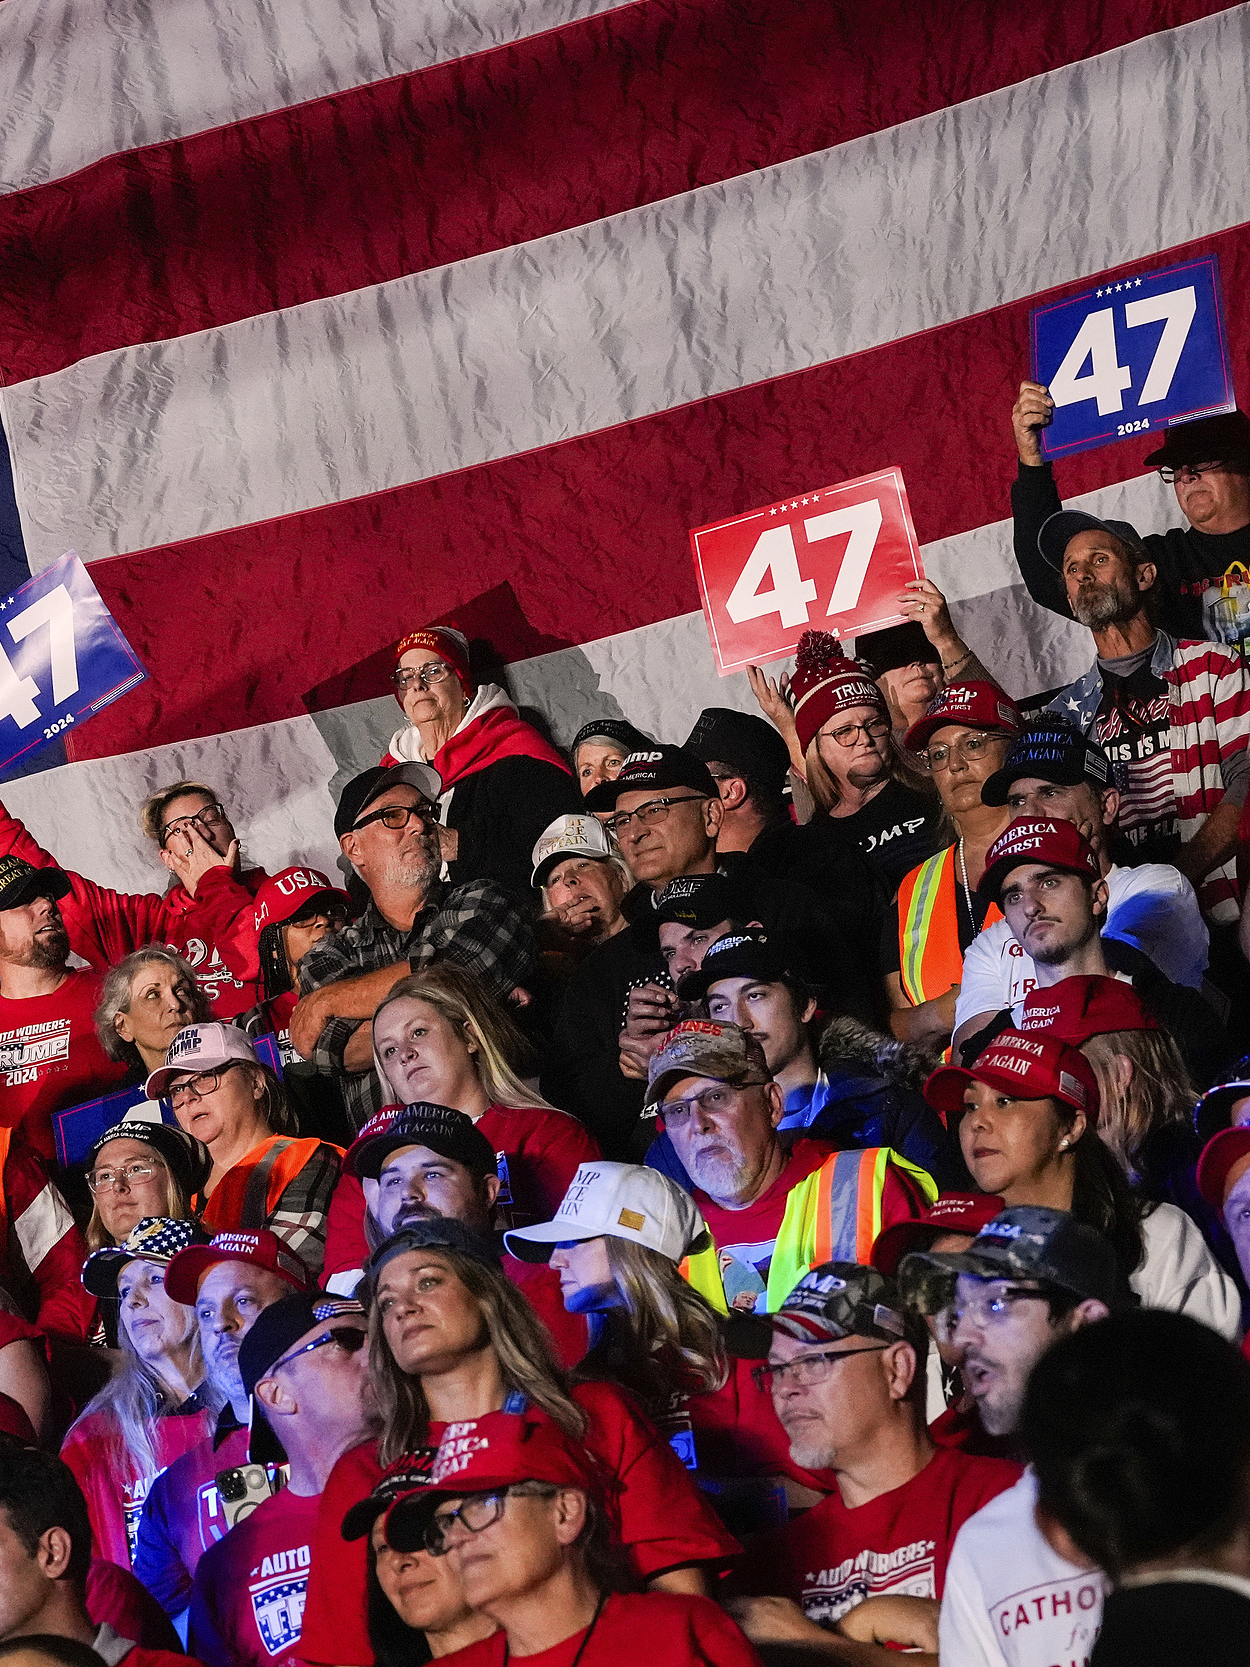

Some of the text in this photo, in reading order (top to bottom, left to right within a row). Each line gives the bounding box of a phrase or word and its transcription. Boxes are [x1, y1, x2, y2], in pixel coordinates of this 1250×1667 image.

[1049, 286, 1197, 416] 47
[1117, 418, 1150, 436] 2024
[725, 498, 883, 630] 47
[832, 682, 878, 701] TRUMP
[43, 713, 75, 739] 2024
[990, 823, 1058, 857] AMERICA
[274, 870, 327, 896] USA
[16, 1020, 65, 1039] WORKERS
[174, 1029, 199, 1043] MEN
[993, 1035, 1044, 1057] AMERICA
[988, 1054, 1032, 1076] AGAIN
[6, 1068, 39, 1087] 2024
[215, 1233, 259, 1245] AMERICA
[219, 1243, 254, 1254] AGAIN
[260, 1545, 311, 1578] AUTO
